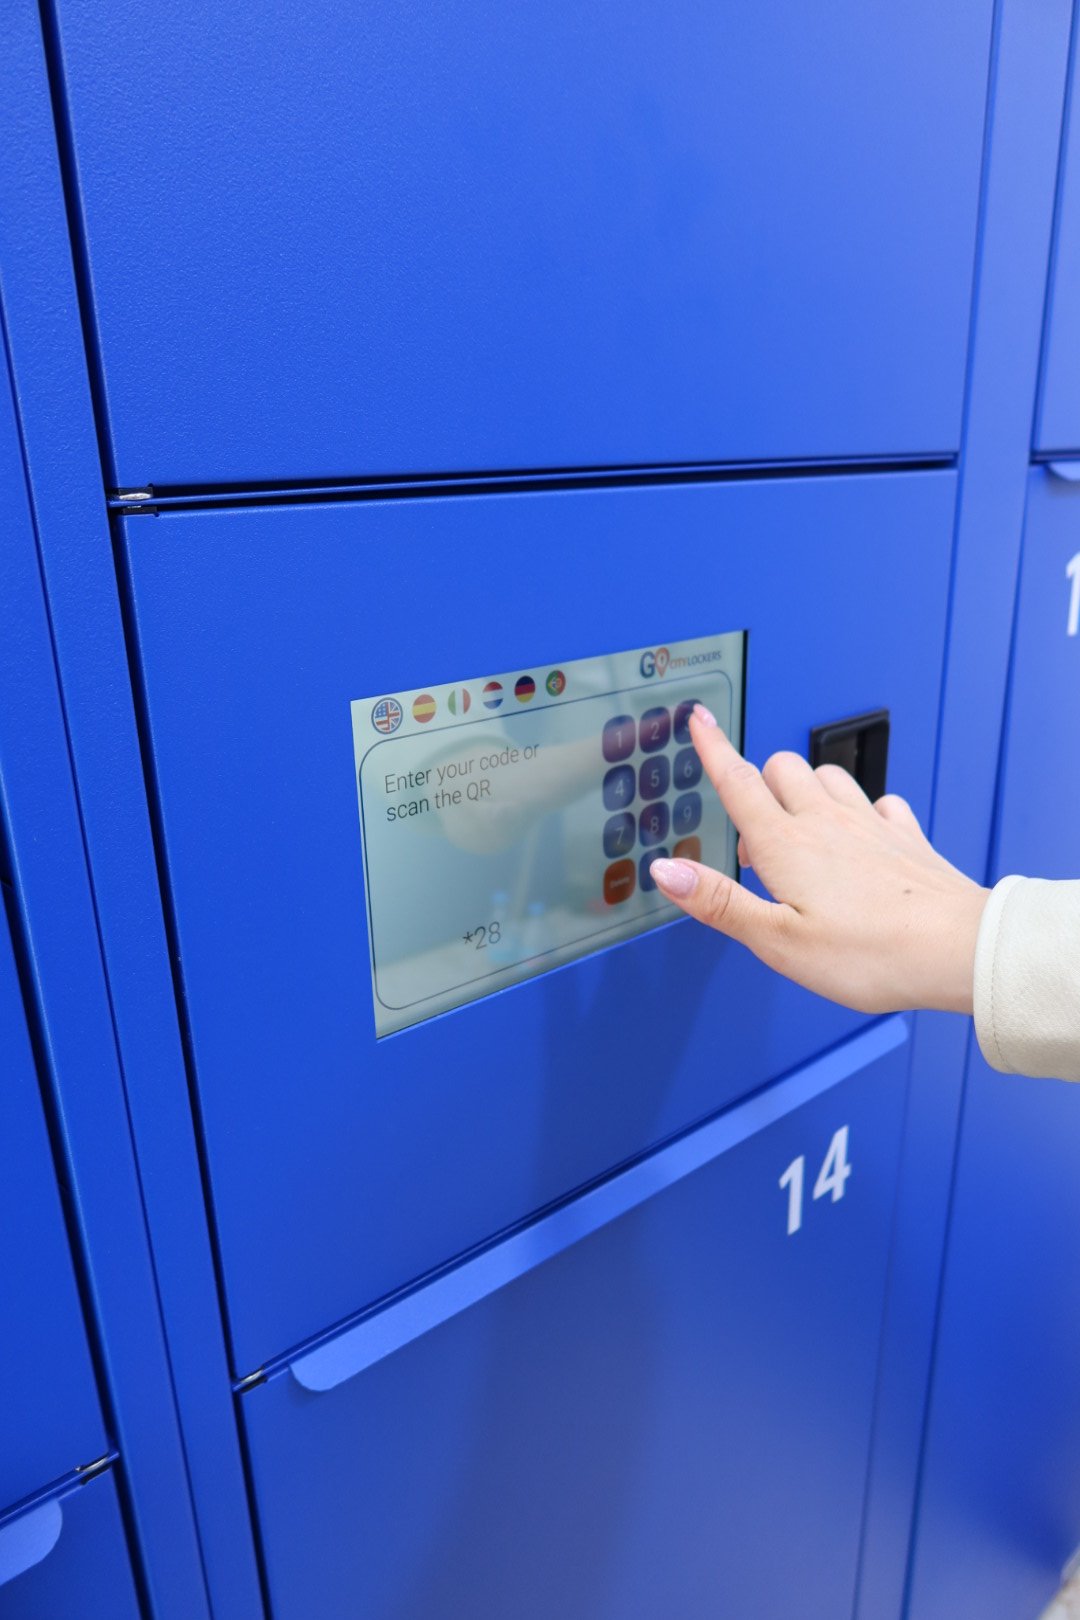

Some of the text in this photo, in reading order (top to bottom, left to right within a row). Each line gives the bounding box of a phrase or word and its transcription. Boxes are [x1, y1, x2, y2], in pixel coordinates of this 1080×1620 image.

[615, 730, 622, 748] 1
[651, 721, 660, 740] 2
[384, 744, 539, 794] Enter your code or
[650, 769, 660, 788] 5
[683, 760, 694, 778] 6
[615, 779, 625, 797] 4
[386, 779, 491, 822] scan the QR
[683, 806, 693, 823] 9
[650, 816, 660, 834] 8
[615, 827, 625, 846] 7
[778, 1123, 852, 1236] 14
